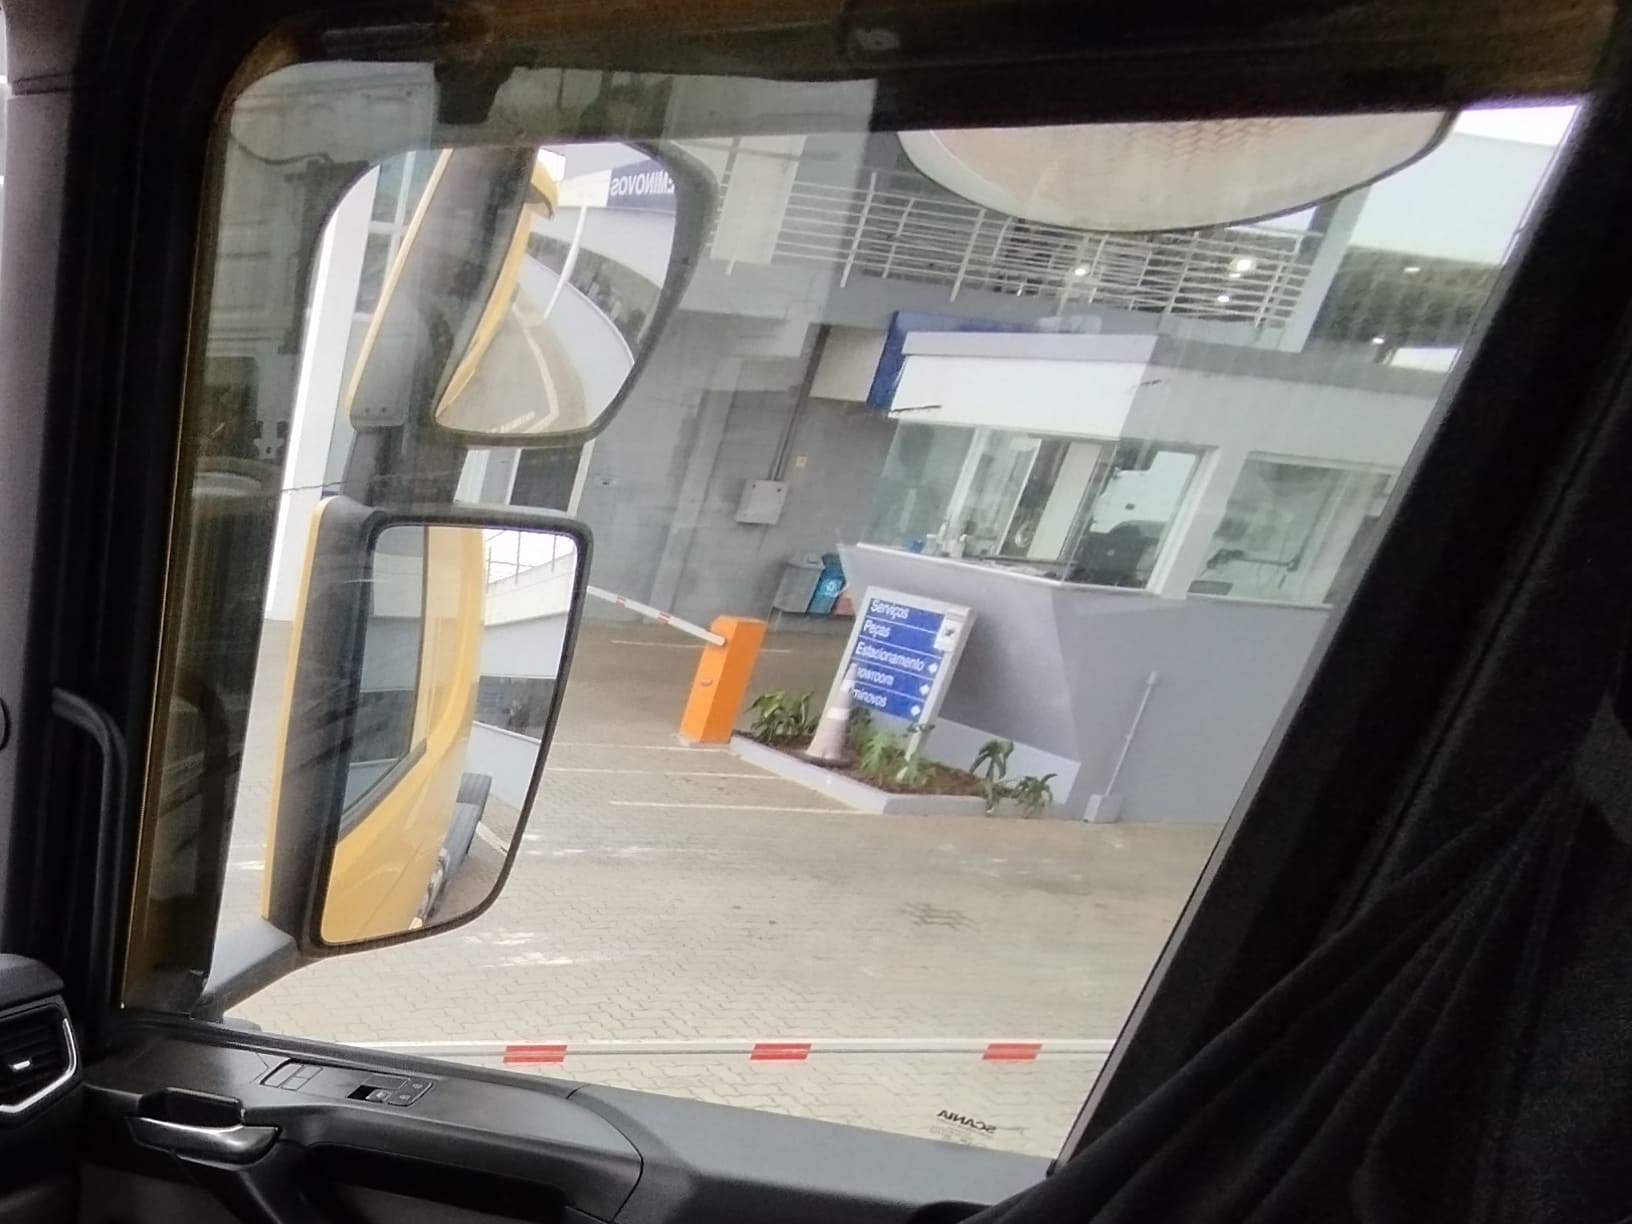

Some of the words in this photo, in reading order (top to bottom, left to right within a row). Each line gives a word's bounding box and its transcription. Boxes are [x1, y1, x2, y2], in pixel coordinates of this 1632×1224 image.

[870, 600, 910, 619] Serviços
[863, 620, 891, 639] Peças
[855, 641, 925, 672] Estacionamento
[856, 667, 895, 687] owroom
[852, 687, 888, 708] minovos
